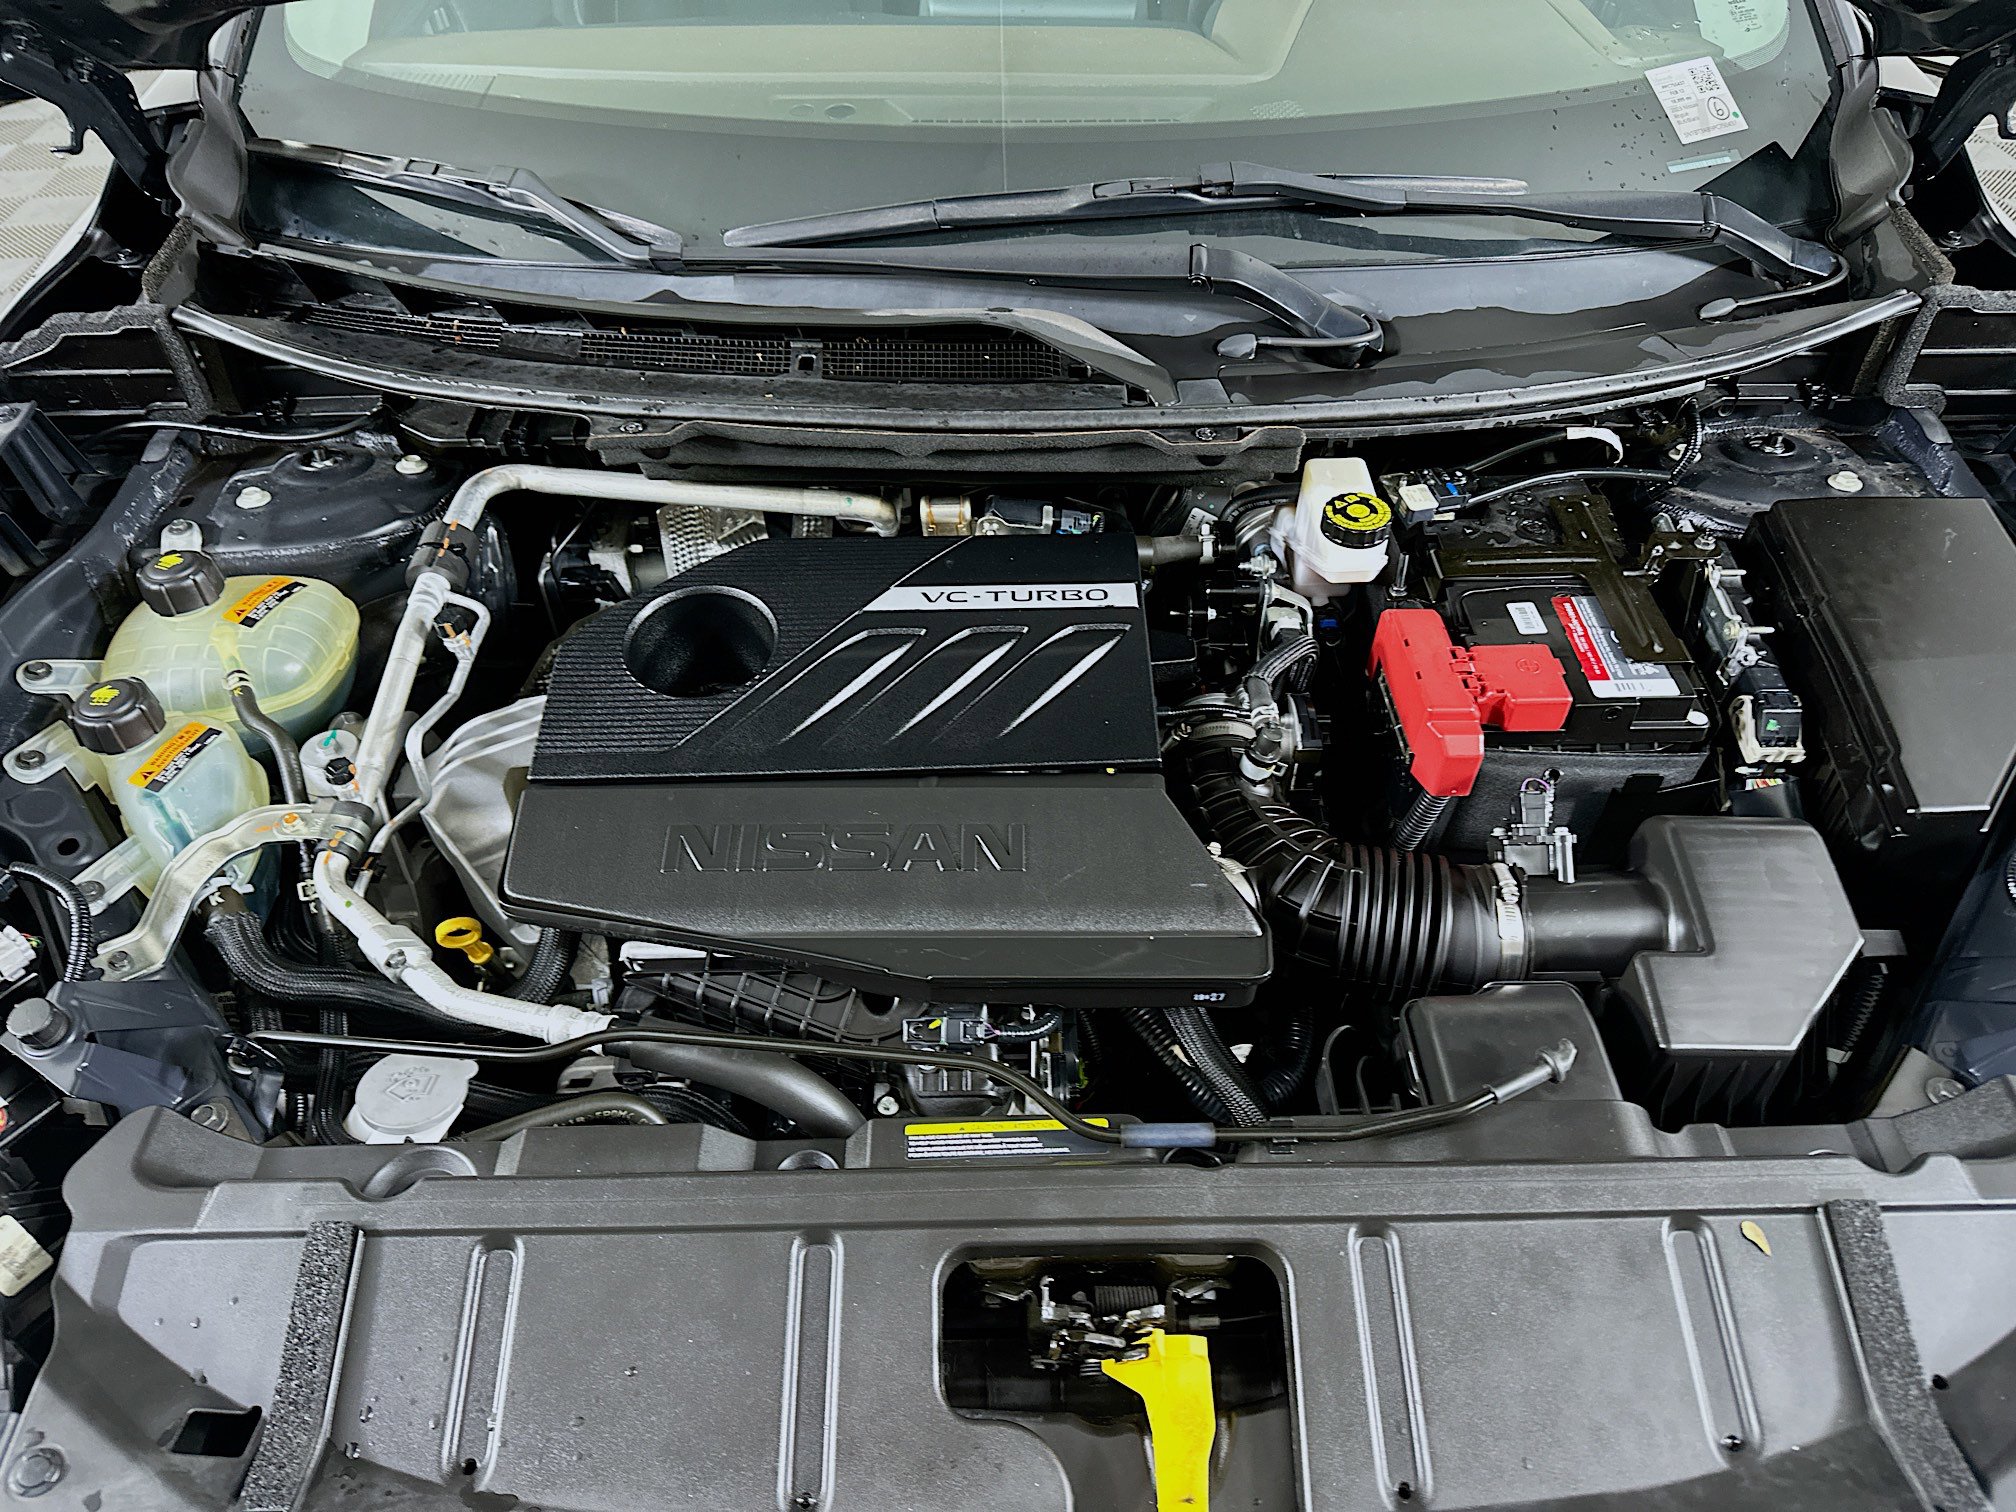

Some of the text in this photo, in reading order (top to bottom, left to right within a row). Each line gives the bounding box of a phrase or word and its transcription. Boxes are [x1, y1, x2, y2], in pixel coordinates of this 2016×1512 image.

[1713, 101, 1724, 117] 6
[921, 588, 1109, 603] VC-TURBO
[661, 823, 1027, 873] NISSAN
